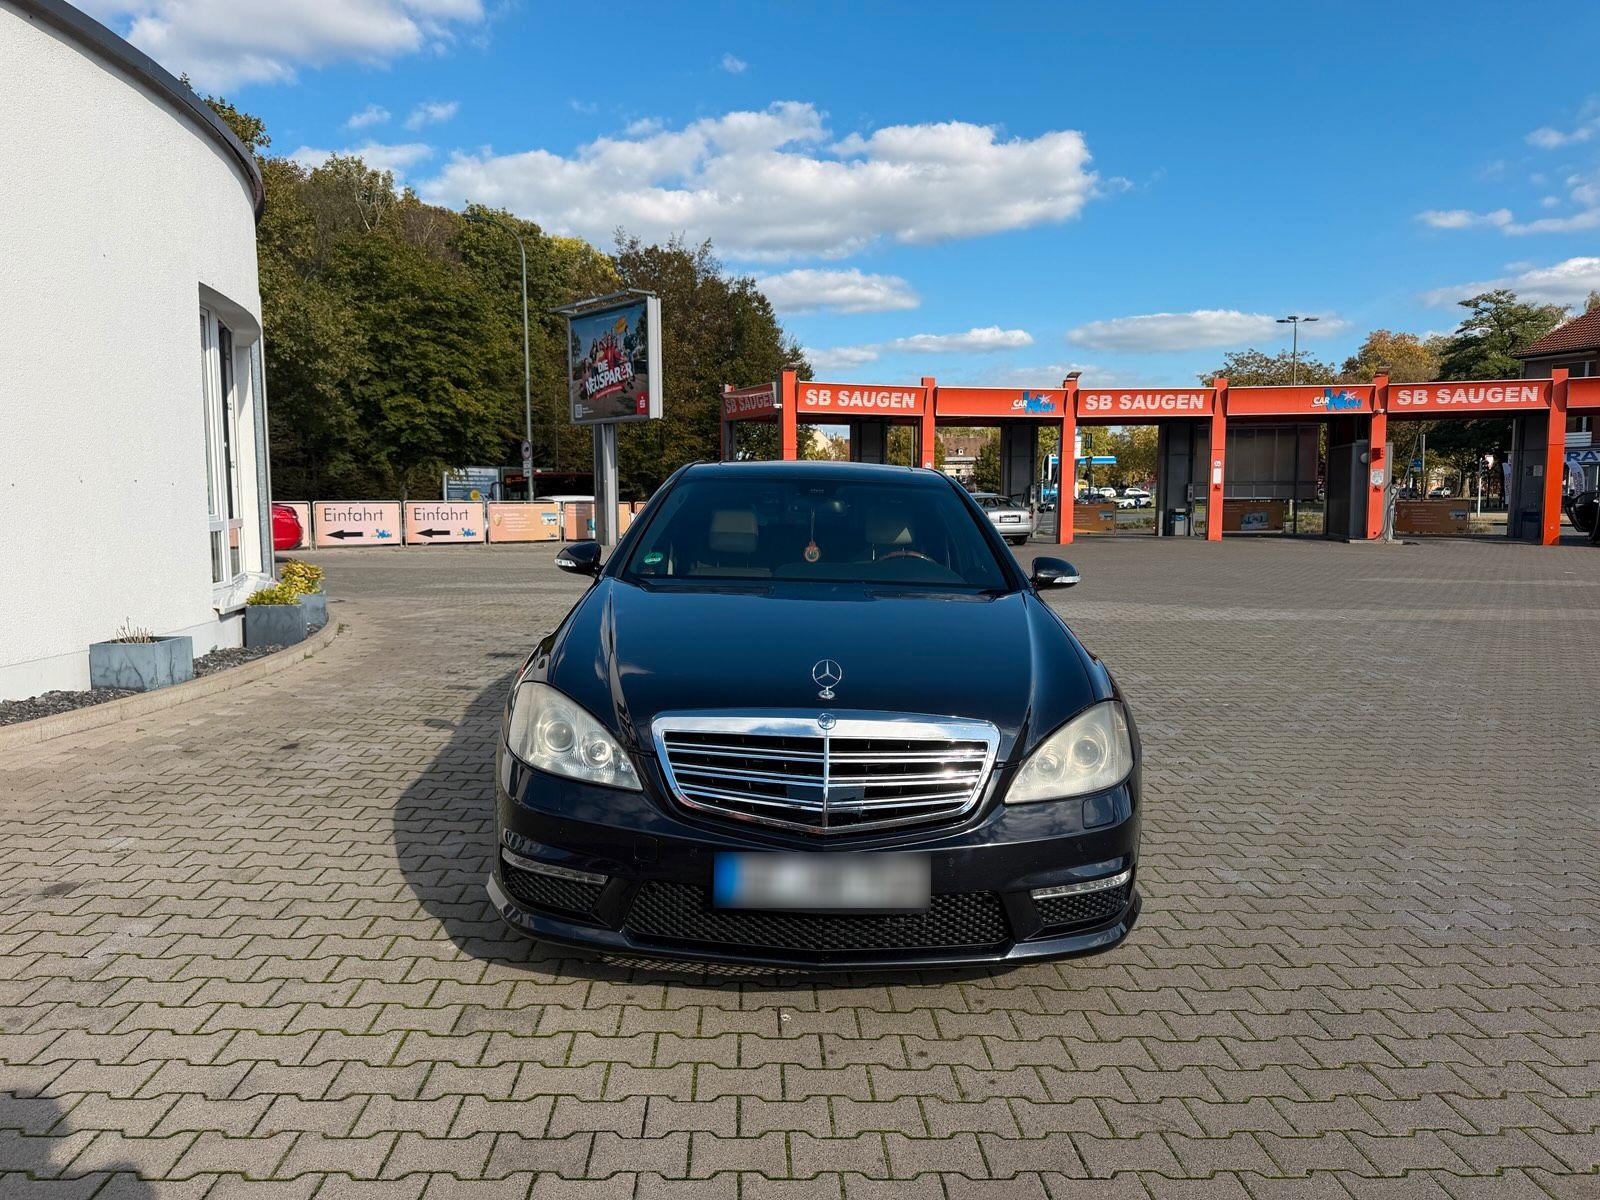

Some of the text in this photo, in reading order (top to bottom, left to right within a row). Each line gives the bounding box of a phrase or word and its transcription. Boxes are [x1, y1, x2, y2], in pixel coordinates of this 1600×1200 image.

[597, 360, 609, 373] DIE
[805, 389, 915, 408] SB SAUGEN
[1085, 394, 1205, 410] SB SAUGEN
[1312, 396, 1330, 405] CAR
[1397, 386, 1538, 405] SB SAUGEN
[725, 397, 737, 413] SB
[1012, 399, 1028, 408] CAR
[324, 507, 384, 522] Einfahrt
[413, 506, 469, 521] Einfahrt
